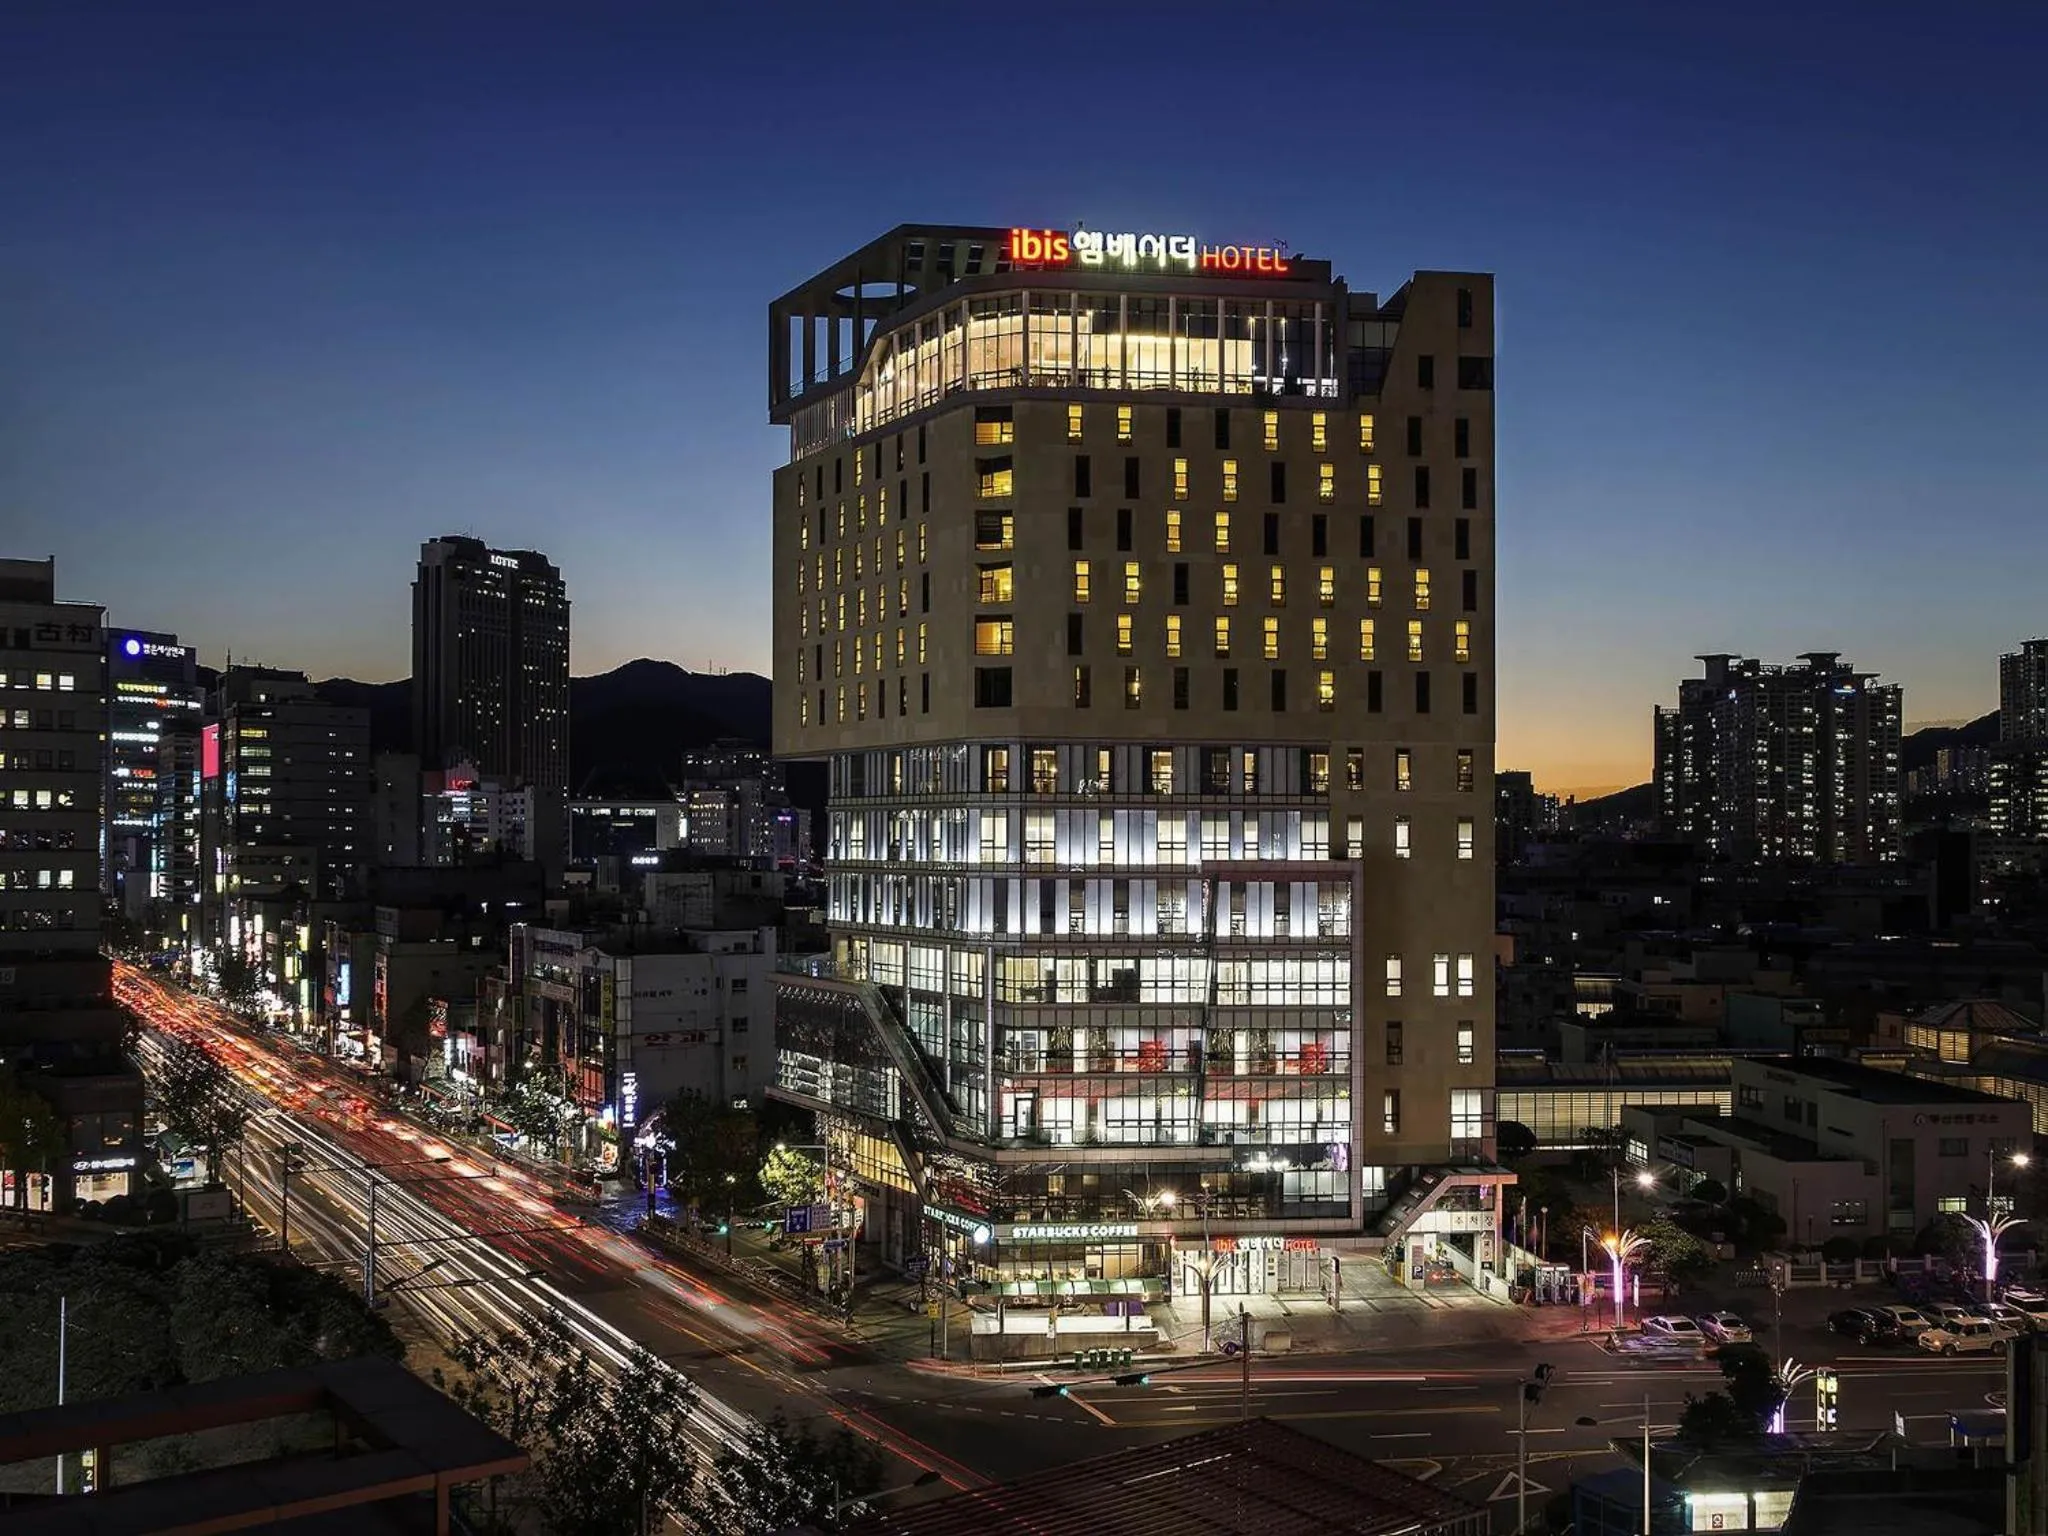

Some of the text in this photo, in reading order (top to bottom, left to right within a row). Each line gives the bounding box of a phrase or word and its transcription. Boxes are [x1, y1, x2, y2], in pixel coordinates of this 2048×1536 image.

[1011, 229, 1068, 261] ibis
[1073, 230, 1197, 268] 앰배서더
[1202, 244, 1289, 272] HOTEL
[490, 555, 519, 568] LOTTE
[1012, 1225, 1138, 1238] STARBUCKS COFFEE
[1285, 1239, 1320, 1251] HOTEL
